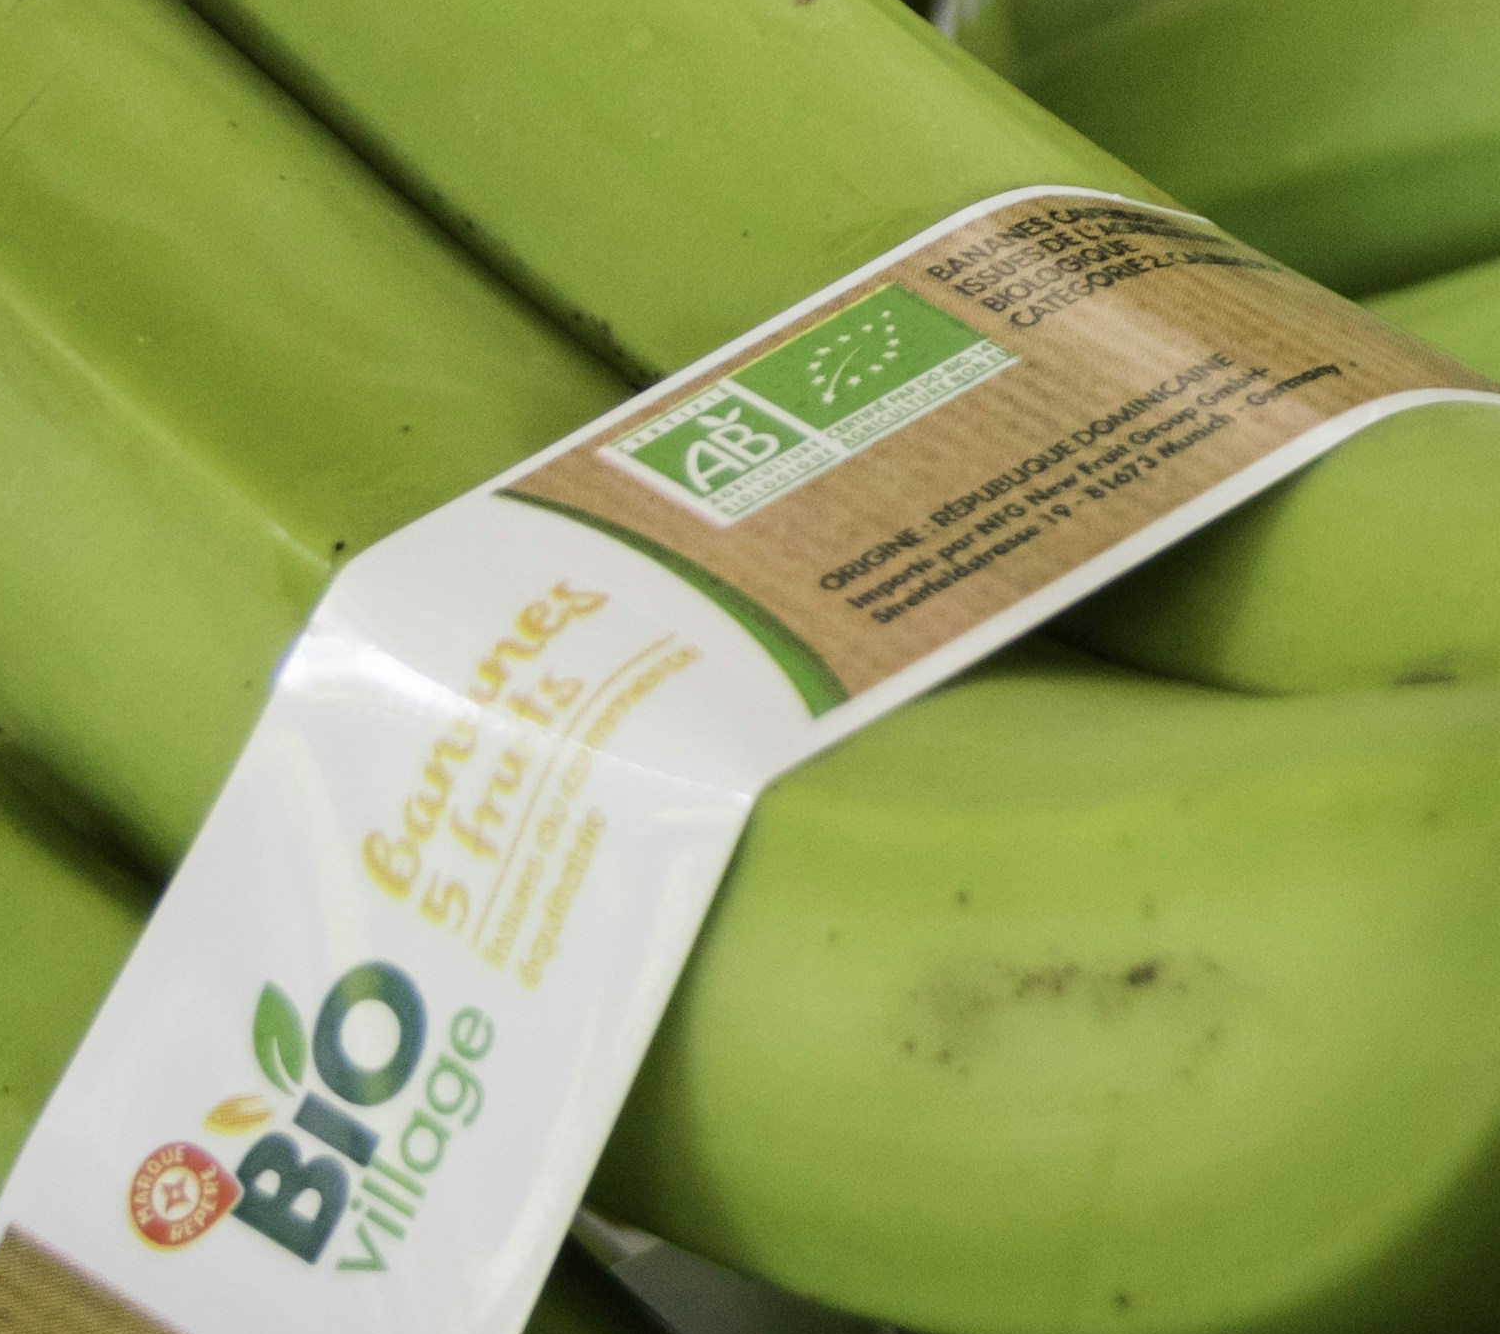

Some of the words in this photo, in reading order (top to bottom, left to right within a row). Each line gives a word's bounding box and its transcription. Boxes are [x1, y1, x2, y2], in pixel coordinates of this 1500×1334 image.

[925, 215, 1053, 284] BANANES
[953, 244, 1044, 298] ISSUES
[1038, 229, 1081, 255] DE
[979, 238, 1141, 314] BIOLOGIQUE
[684, 423, 781, 493] AB
[820, 527, 927, 591] ORIGINE
[930, 440, 1079, 528] RÉPUBLIQUE
[1070, 351, 1237, 447] DOMINICAINE
[1040, 502, 1073, 526] 19
[1157, 412, 1234, 460] Munich
[845, 554, 936, 610] Importé
[936, 531, 976, 564] par
[974, 502, 1027, 536] NFG
[1023, 473, 1079, 506] New
[1075, 444, 1131, 476] Fruit
[1128, 405, 1200, 447] Group
[417, 868, 472, 937] 5
[231, 957, 429, 1267] BIO
[334, 1004, 496, 1272] village
[132, 1143, 187, 1229] MARQUE
